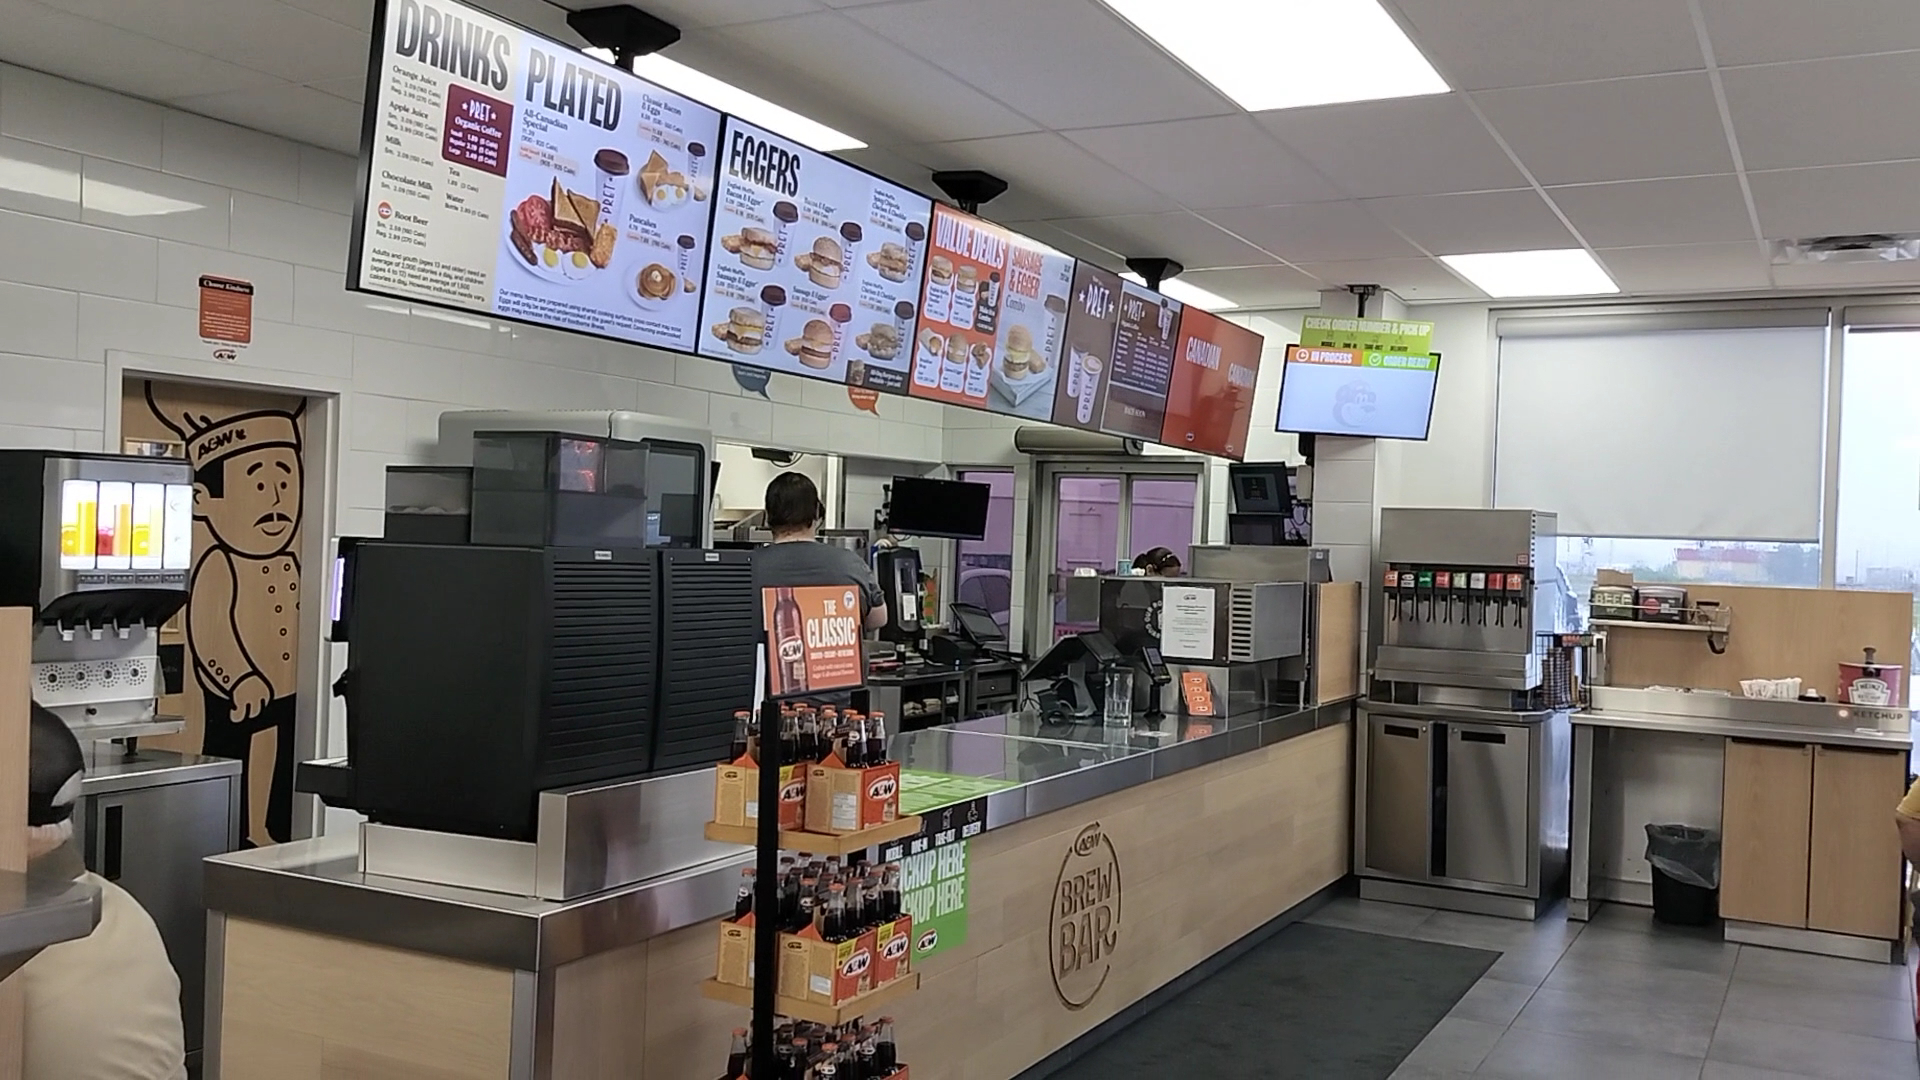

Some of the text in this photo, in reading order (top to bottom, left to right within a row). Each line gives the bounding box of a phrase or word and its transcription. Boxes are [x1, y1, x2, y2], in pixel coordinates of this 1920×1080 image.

[396, 0, 511, 91] DRINKS
[392, 64, 438, 87] Orange Juice
[526, 47, 622, 132] PLATED
[389, 100, 429, 120] Apple Juice
[469, 98, 492, 122] PRET
[524, 108, 568, 131] All-Canadian
[454, 116, 503, 138] Organic Coffee
[523, 117, 548, 133] Special
[384, 135, 402, 147] Milk
[448, 166, 460, 178] Tea
[728, 129, 800, 198] EGGERS
[381, 170, 434, 191] Chocolate Milk
[446, 192, 465, 204] Water
[602, 182, 616, 214] PRET
[394, 210, 429, 226] Root Beer
[629, 213, 657, 229] Pancakes
[935, 212, 972, 257] VALUE
[972, 229, 1006, 270] DEALS
[372, 247, 390, 257] Adults
[391, 252, 402, 260] and
[402, 254, 418, 263] youth
[371, 257, 393, 266] average
[417, 266, 438, 275] calories
[369, 273, 391, 282] calories
[1006, 294, 1026, 313] Combo
[1085, 284, 1110, 319] PRET
[1305, 317, 1331, 330] CHECK
[1186, 336, 1222, 371] CANADIAN
[1310, 352, 1352, 364] IN PROCESS
[823, 600, 837, 616] THE
[806, 616, 856, 648] CLASSIC
[782, 642, 802, 658] A&W
[1860, 683, 1880, 692] HEINZ
[1853, 710, 1904, 720] KETCHUP
[782, 784, 805, 802] A&W
[872, 782, 894, 799] A&W
[1078, 832, 1101, 852] A&W
[937, 840, 967, 880] HERE
[936, 875, 966, 918] HERE
[1060, 862, 1113, 920] BREW
[884, 939, 908, 960] A&W
[918, 934, 937, 950] A&W
[1058, 904, 1117, 981] BAR
[844, 954, 870, 976] A&W
